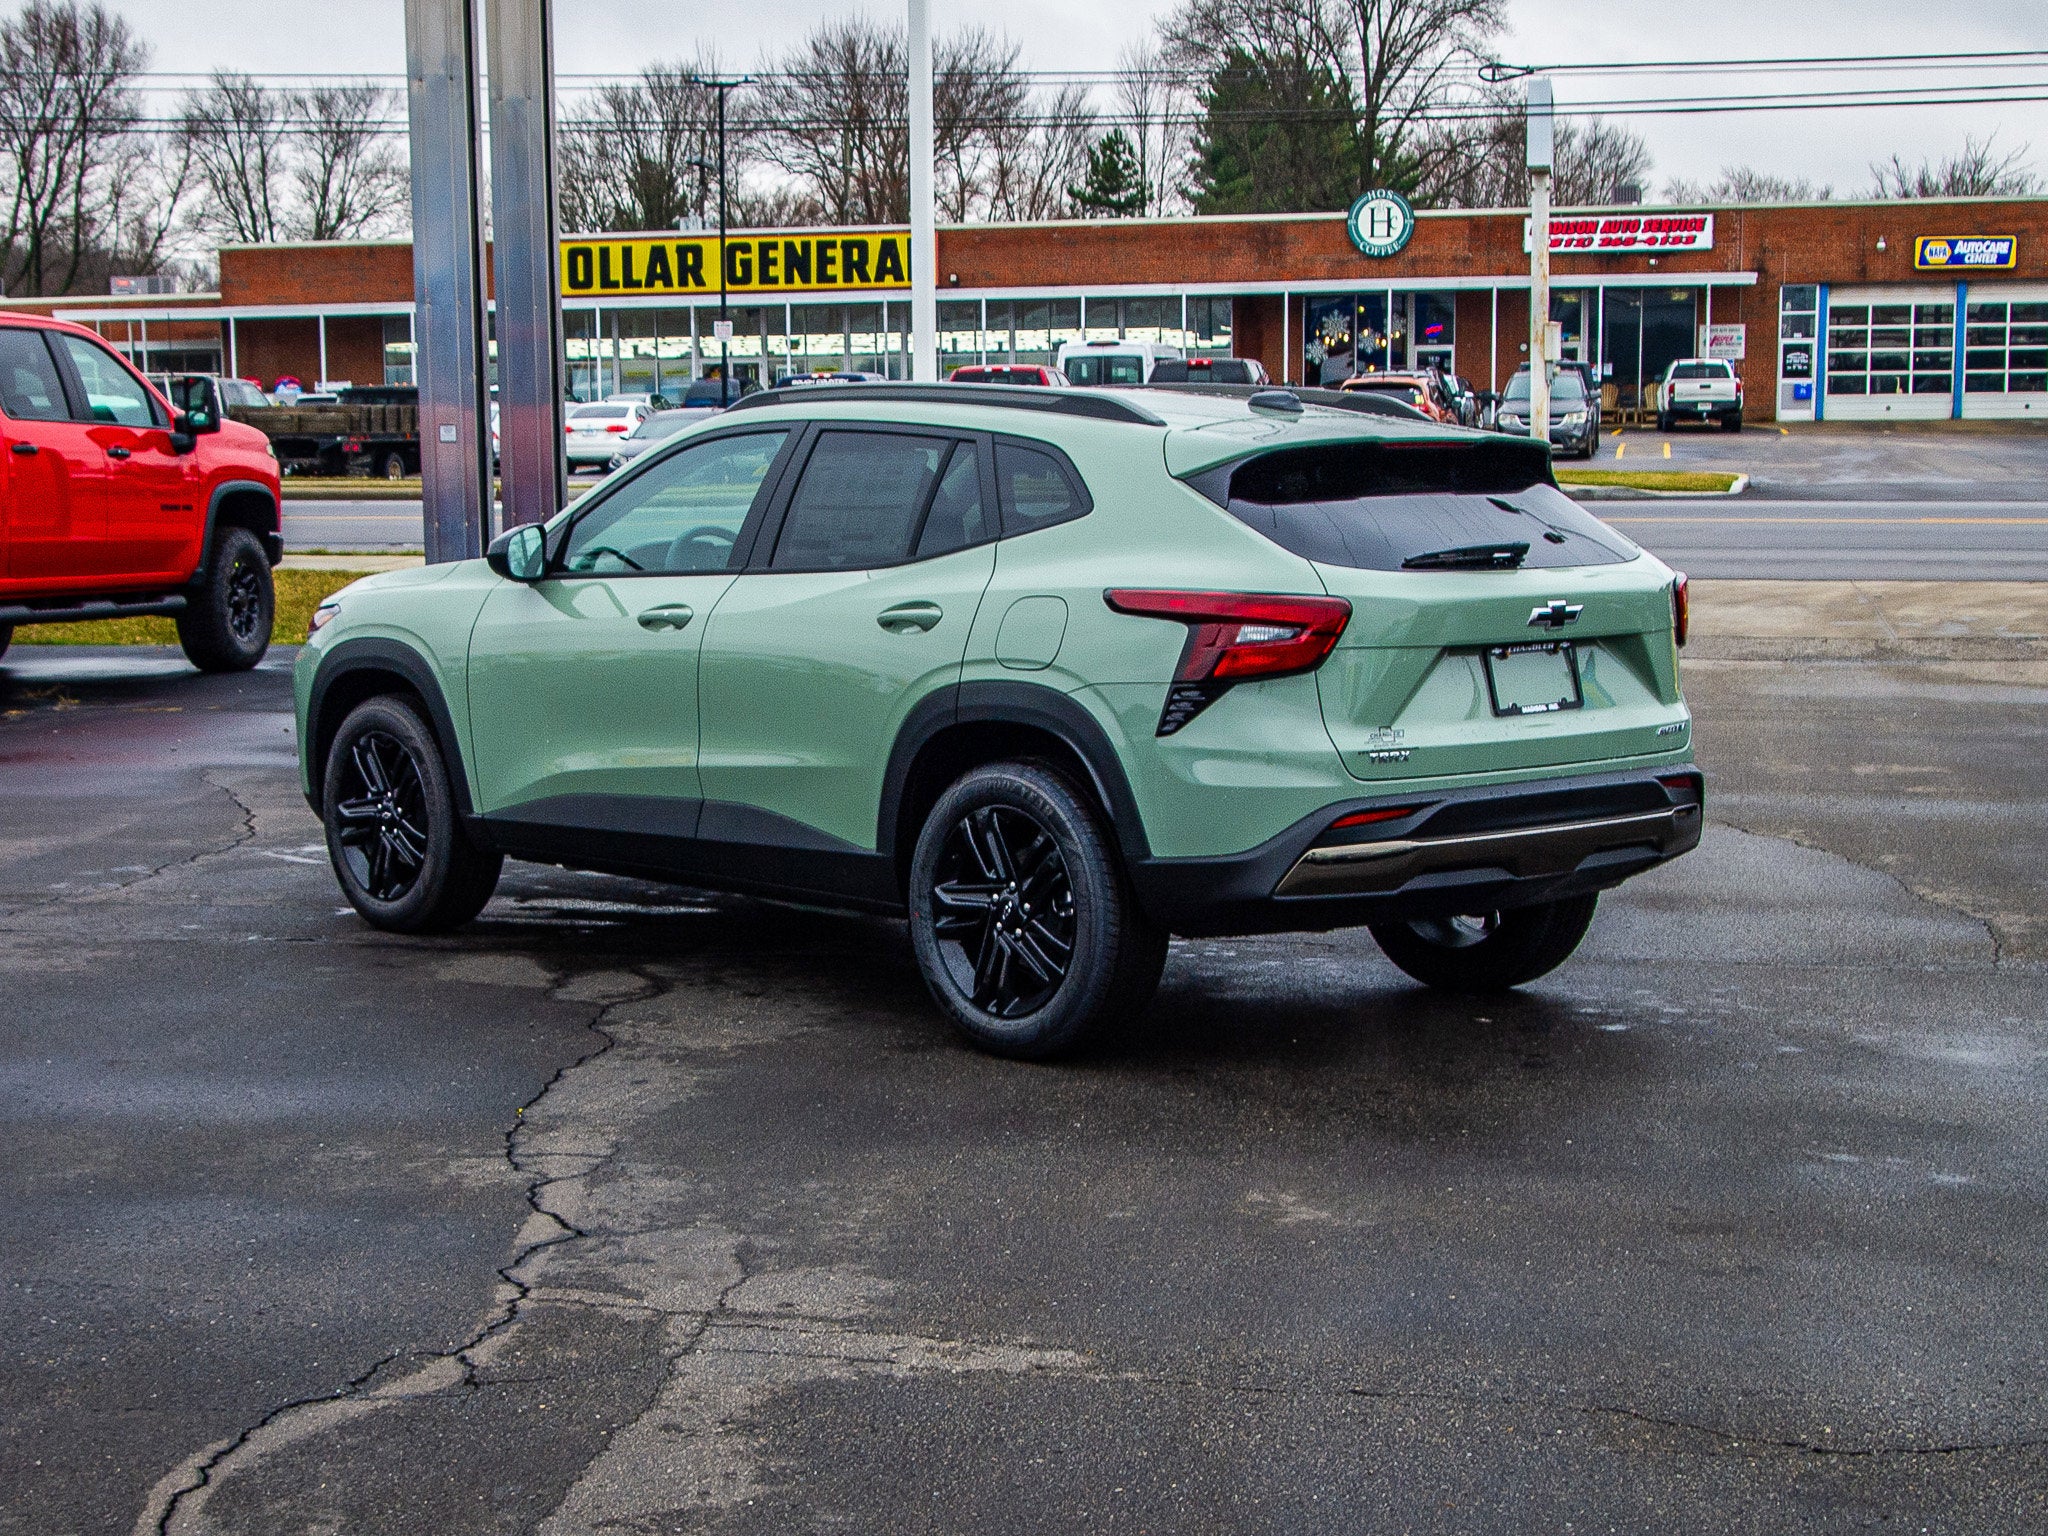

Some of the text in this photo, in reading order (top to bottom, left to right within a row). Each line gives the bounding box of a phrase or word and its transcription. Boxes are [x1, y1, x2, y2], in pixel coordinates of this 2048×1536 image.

[1367, 188, 1394, 200] HOS
[1530, 216, 1707, 236] DISON AUTO SERVICE
[1359, 241, 1401, 257] COFFEE
[1928, 246, 1948, 258] NAPA
[567, 238, 912, 290] OLLAR GENERA
[1964, 253, 1998, 265] CENTER
[1508, 643, 1555, 653] CHANDLER
[1369, 750, 1410, 764] TRAX
